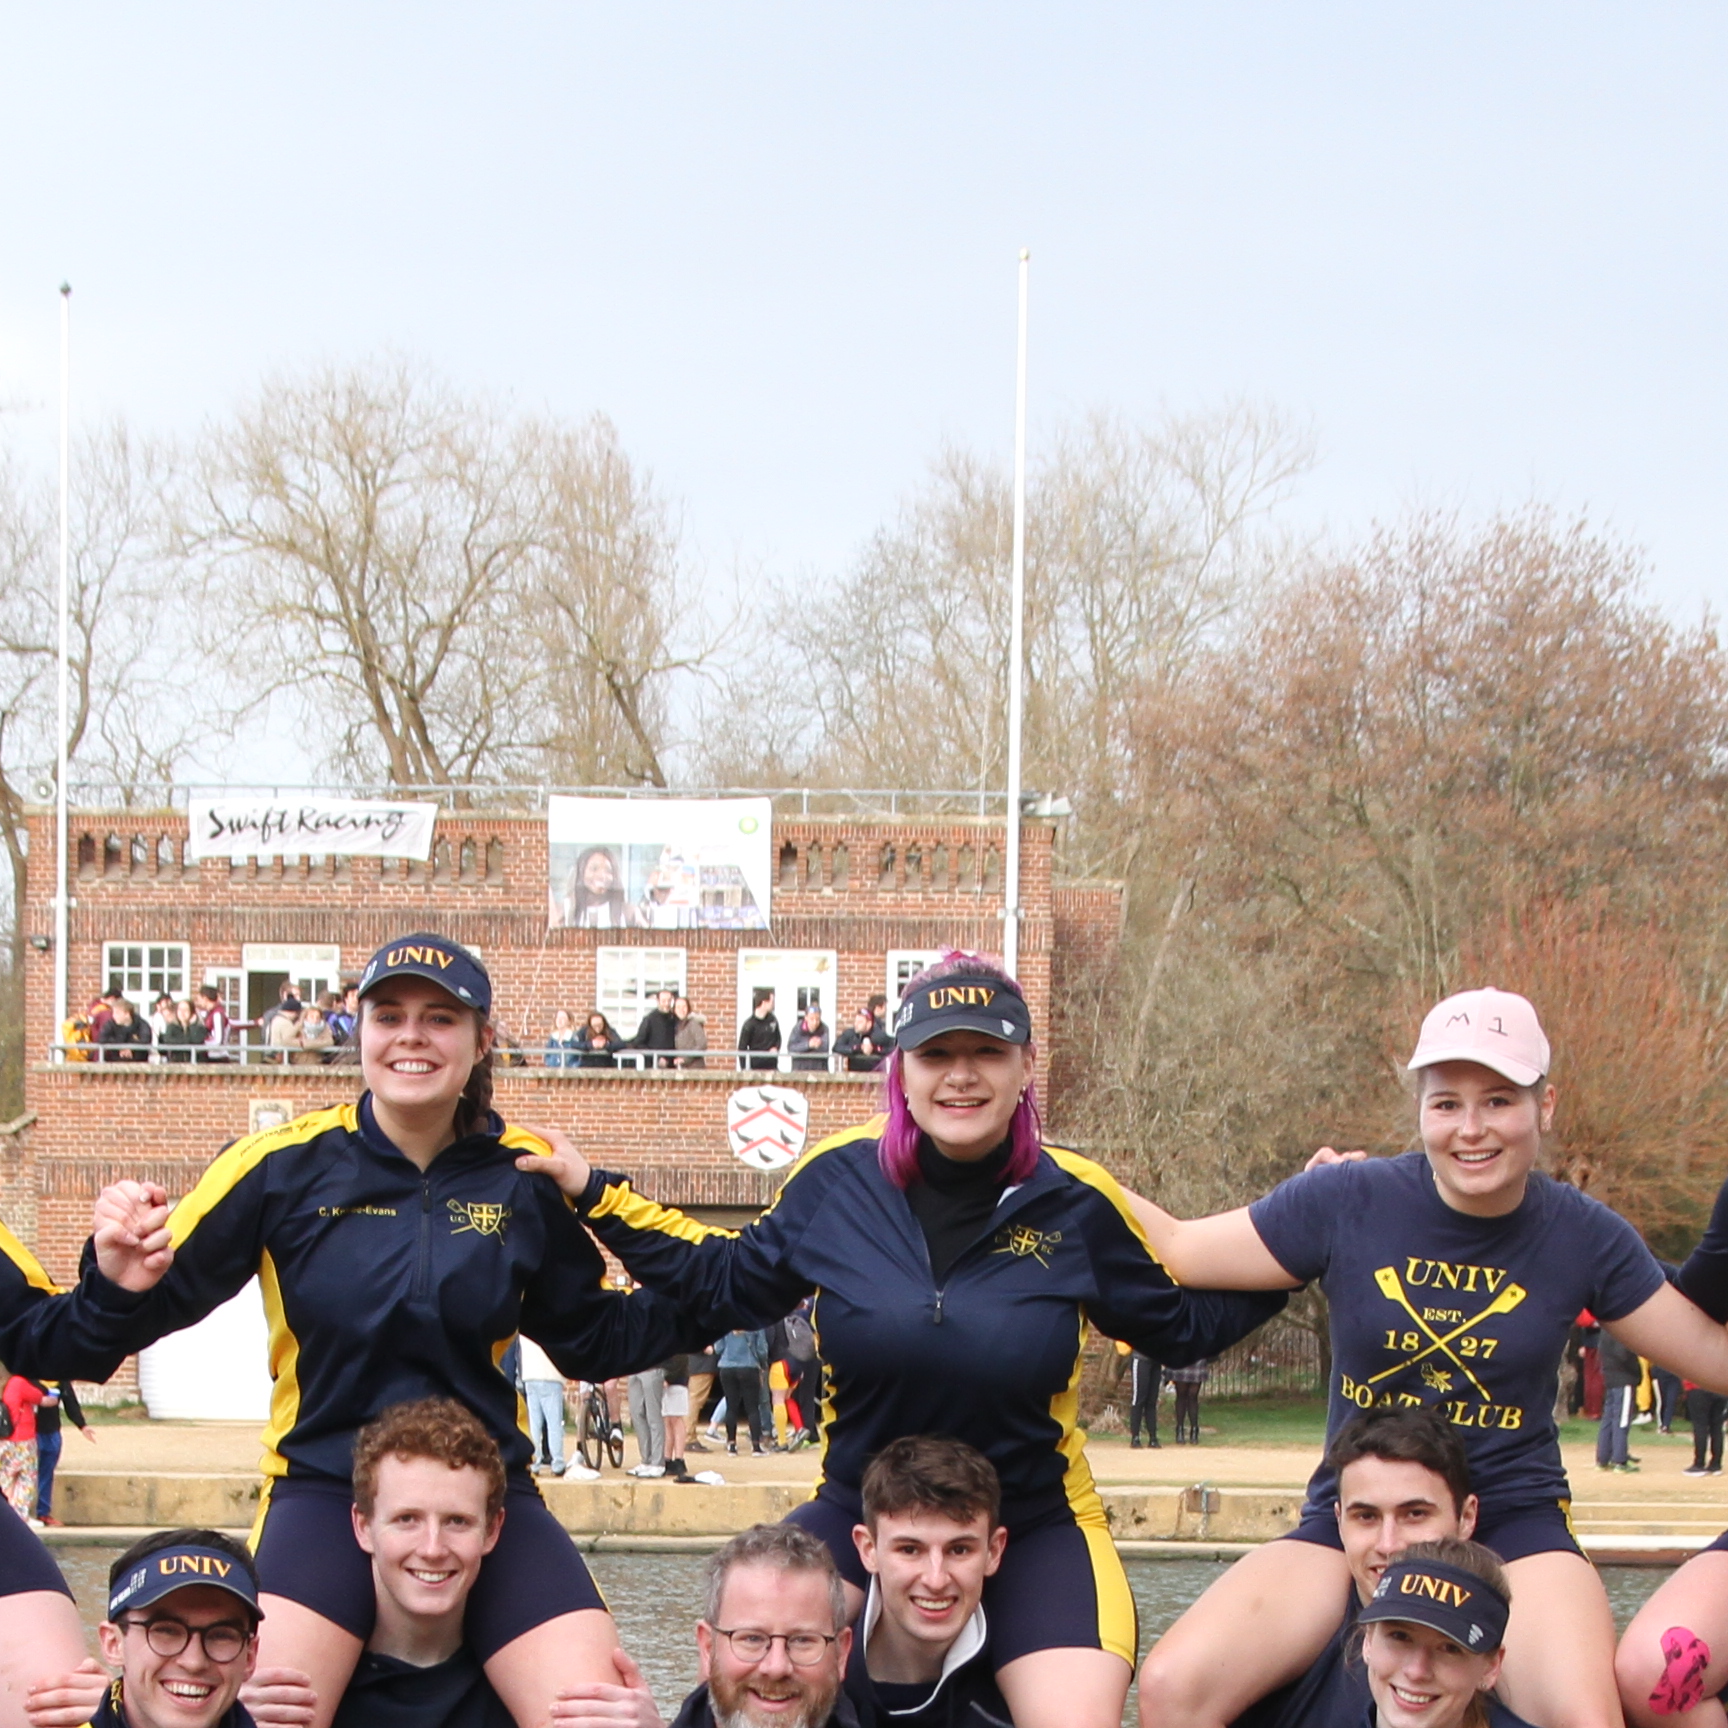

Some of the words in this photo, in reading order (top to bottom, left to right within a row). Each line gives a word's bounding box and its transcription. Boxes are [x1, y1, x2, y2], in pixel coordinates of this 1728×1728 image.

[208, 805, 288, 843] Swift
[297, 805, 413, 841] Racing
[386, 946, 454, 969] UNIV
[928, 985, 996, 1009] UNIV
[1445, 1012, 1470, 1028] M
[1487, 1016, 1509, 1037] 1
[1404, 1256, 1507, 1294] UNIV
[1423, 1307, 1467, 1324] EST.
[1383, 1329, 1421, 1351] 18
[1459, 1335, 1498, 1359] 27
[1444, 1400, 1523, 1431] LUB
[159, 1555, 231, 1578] UNIV
[1400, 1573, 1472, 1608] UNIV
